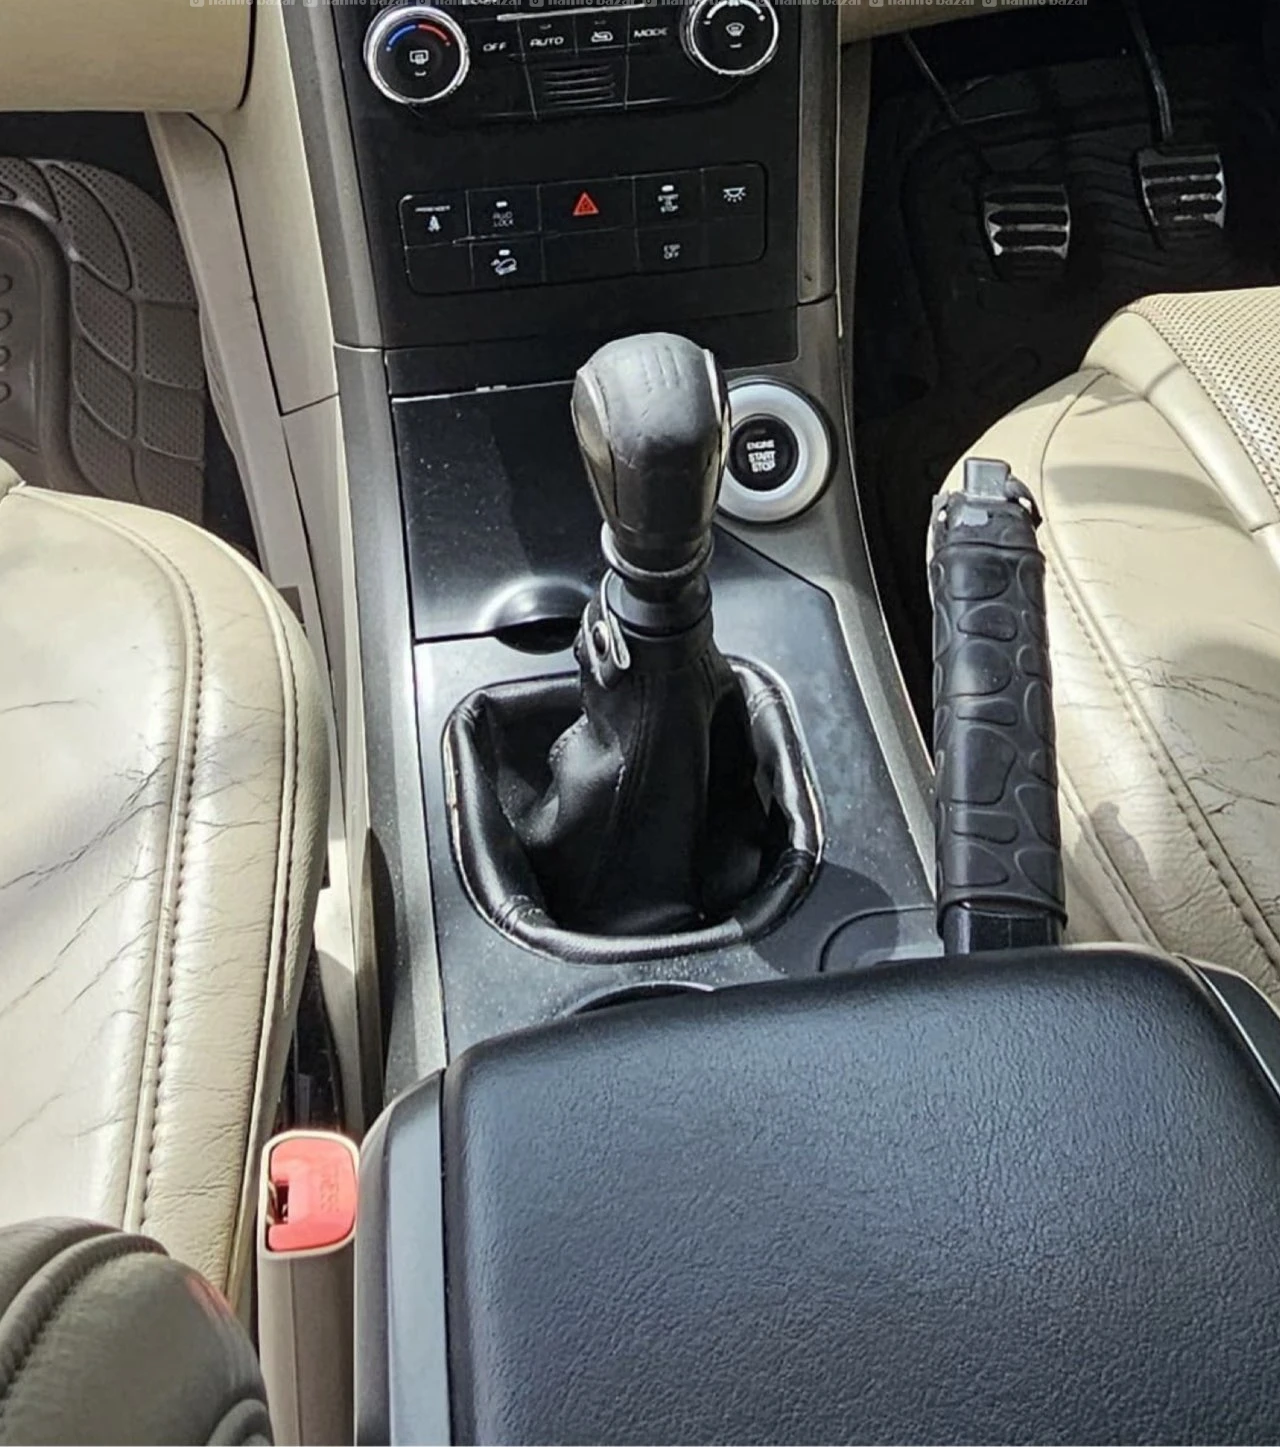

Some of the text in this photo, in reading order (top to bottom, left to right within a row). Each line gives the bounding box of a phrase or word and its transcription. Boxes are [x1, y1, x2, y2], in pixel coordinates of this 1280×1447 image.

[633, 27, 668, 38] MODE
[483, 41, 507, 52] OFF
[530, 36, 564, 47] AUTO
[746, 439, 774, 450] ENGINE
[748, 450, 776, 462] START
[751, 461, 776, 472] STOP
